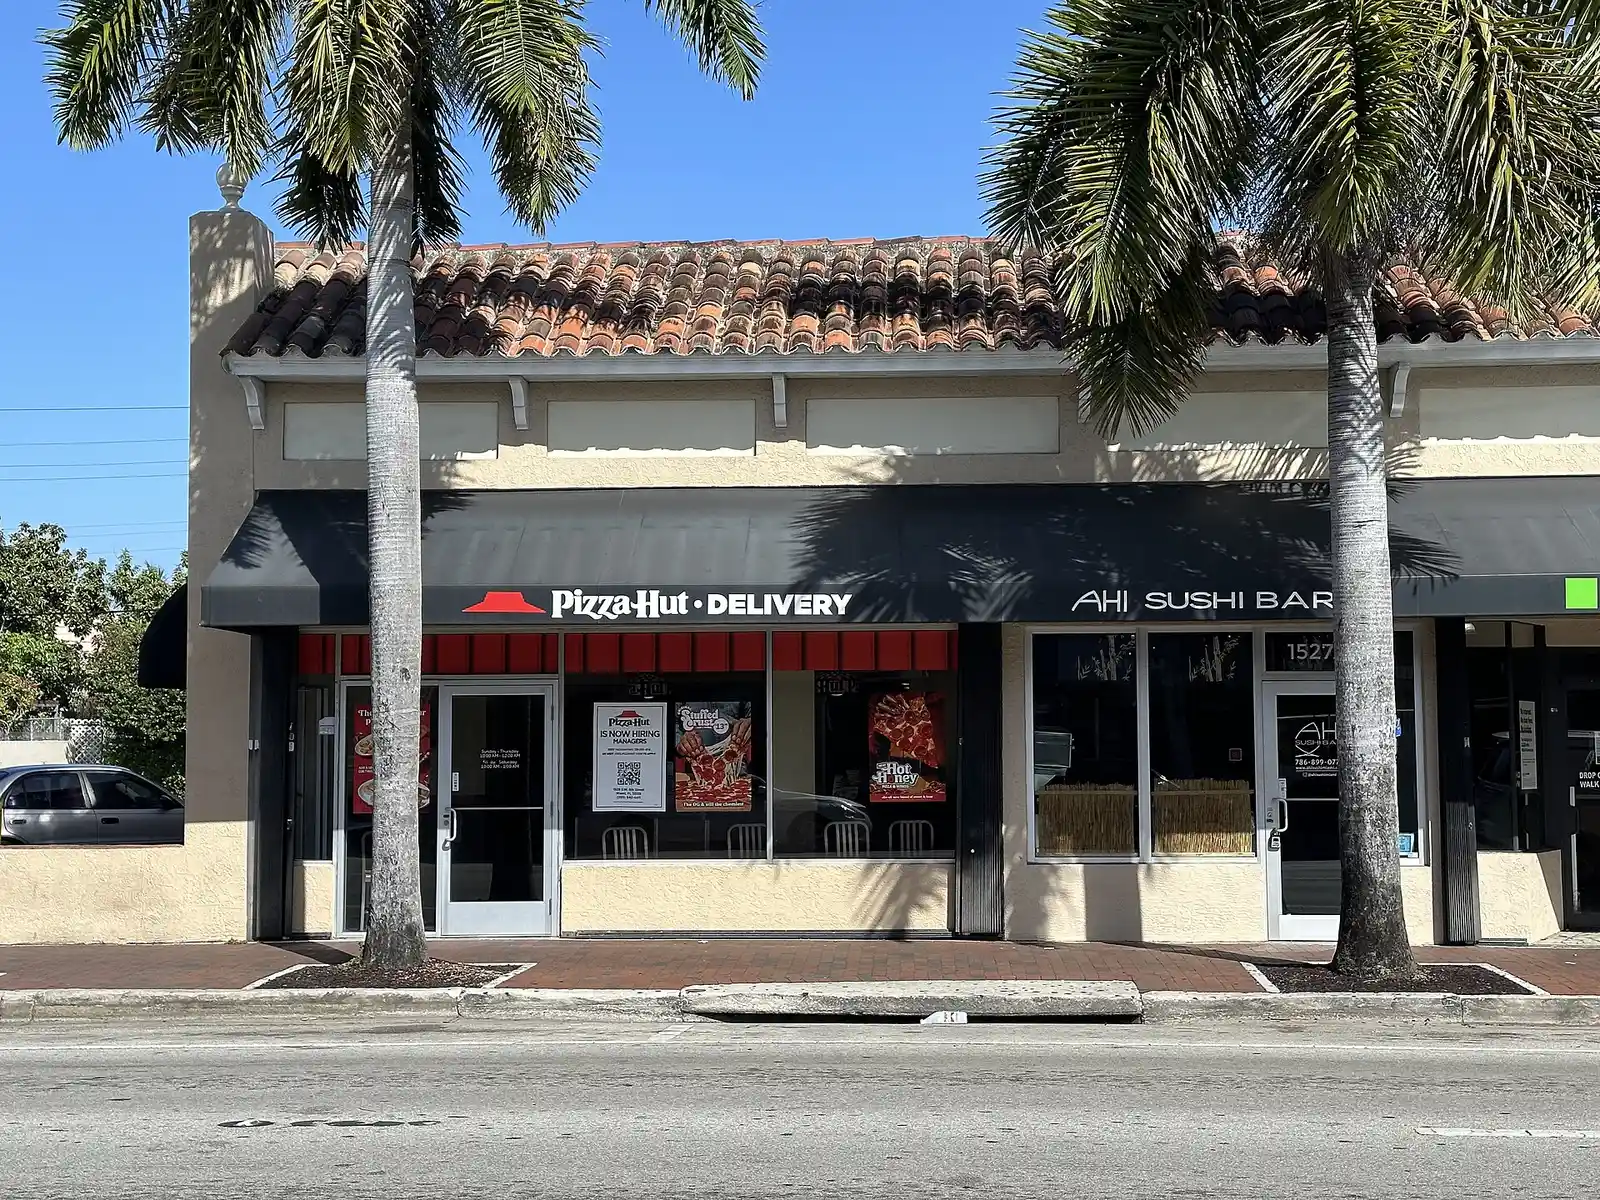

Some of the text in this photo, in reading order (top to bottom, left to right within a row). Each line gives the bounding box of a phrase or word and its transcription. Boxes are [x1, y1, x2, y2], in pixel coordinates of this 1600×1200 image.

[551, 588, 852, 620] Pizza Hut DELIVERY
[1071, 590, 1334, 613] AHI SUSHI BAR
[1287, 643, 1334, 660] 1527
[681, 707, 718, 721] Stuffed
[609, 717, 650, 727] Pizza Hut
[682, 719, 715, 731] Crust
[600, 730, 660, 738] IS NOW HIRING
[1295, 722, 1337, 740] AH
[887, 762, 912, 775] Hot
[1579, 771, 1596, 779] DROP
[1579, 780, 1600, 788] WALK
